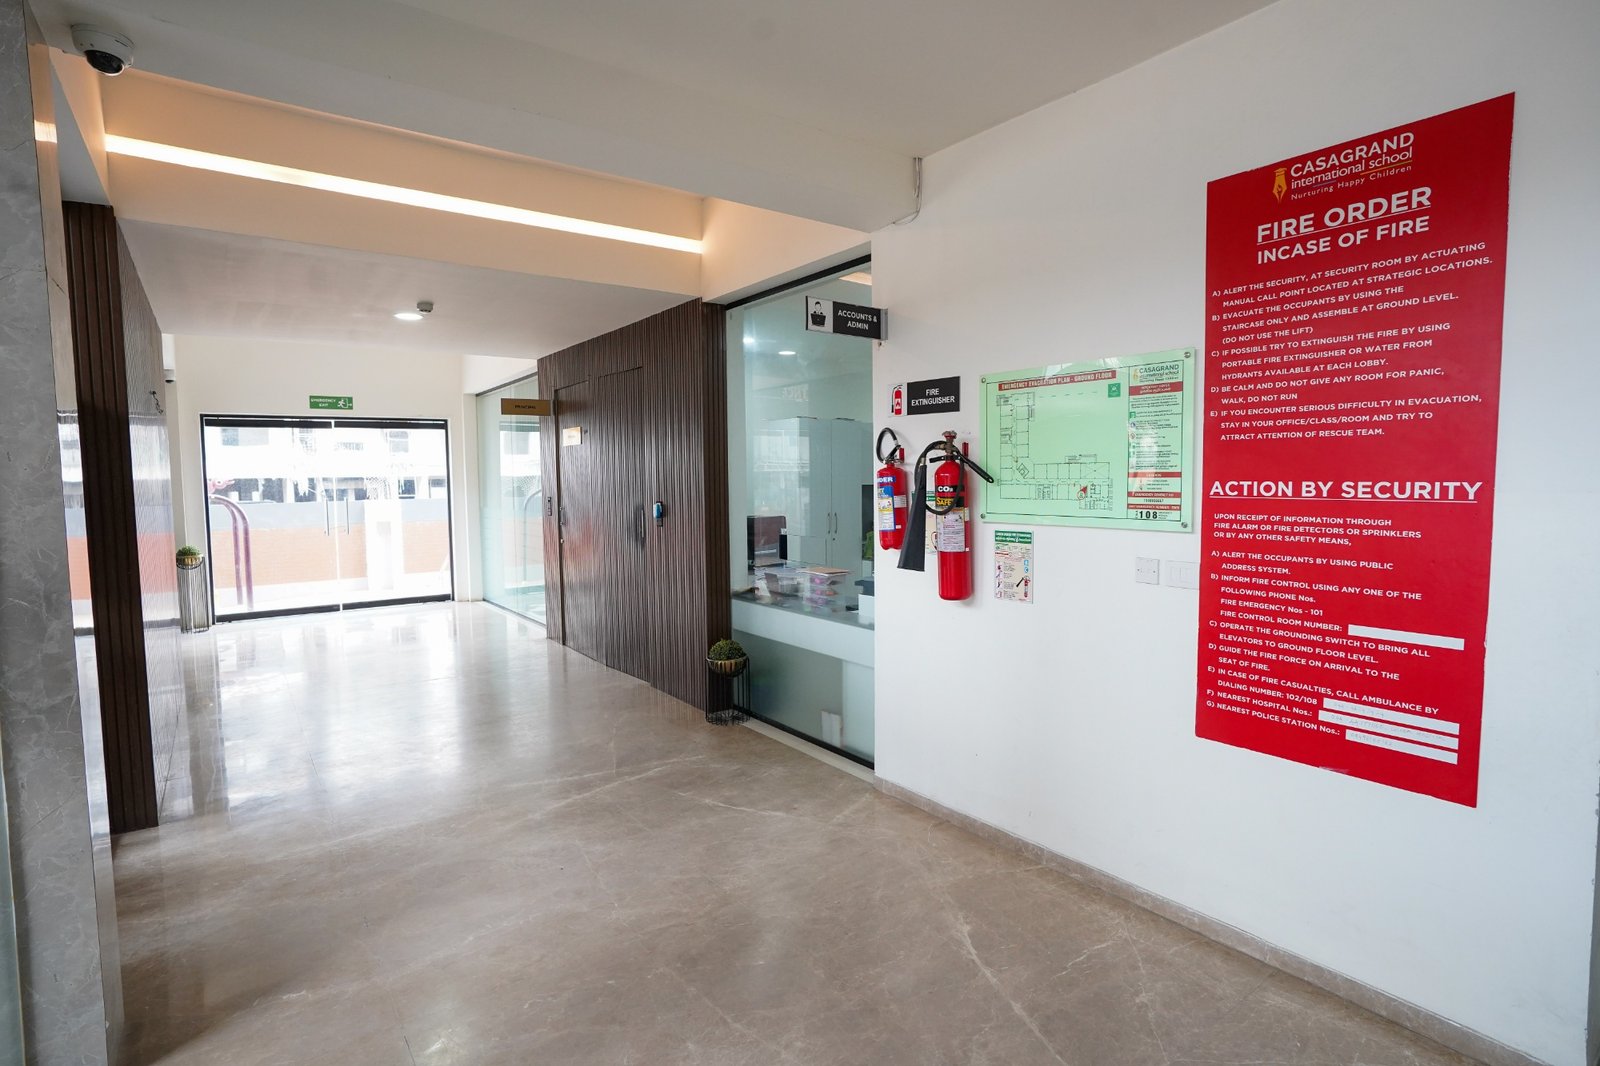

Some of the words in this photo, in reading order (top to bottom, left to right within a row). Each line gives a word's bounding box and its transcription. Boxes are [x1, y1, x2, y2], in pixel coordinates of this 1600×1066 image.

[1290, 132, 1414, 177] CASAGRAND
[1291, 159, 1365, 189] international
[1368, 146, 1412, 168] school
[1291, 185, 1333, 200] Nurturing
[1337, 177, 1365, 188] Happy
[1369, 165, 1411, 180] Children
[1257, 213, 1314, 242] FIRE
[1323, 186, 1431, 227] ORDER
[1258, 236, 1331, 264] INCASE
[1338, 228, 1369, 247] OF
[1376, 215, 1429, 240] FIRE
[1223, 285, 1247, 295] ALERT
[1249, 282, 1264, 290] THE
[1266, 275, 1308, 287] SECURITY,
[1310, 271, 1322, 279] AT
[1324, 263, 1369, 277] SECURITY
[1371, 257, 1401, 269] ROOM
[1404, 254, 1418, 263] BY
[1421, 242, 1485, 260] ACTUATING
[1223, 297, 1255, 307] MANUAL
[1257, 293, 1277, 301] CALL
[1279, 288, 1305, 298] POINT
[1307, 281, 1349, 293] LOCATED
[1351, 278, 1364, 286] AT
[1366, 268, 1422, 283] STRATEGIC
[1425, 256, 1492, 274] LOCATIONS.
[1222, 307, 1263, 319] EVACUATE
[1265, 304, 1281, 312] THE
[1283, 296, 1336, 310] OCCUPANTS
[1338, 294, 1350, 302] BY
[1352, 289, 1382, 299] USING
[1384, 285, 1404, 294] THE
[838, 309, 872, 321] ACCOUNTS
[847, 321, 869, 330] ADMIN
[1231, 345, 1267, 354] POSSIBLE
[1269, 342, 1285, 350] TRY
[1301, 334, 1353, 347] EXTINGUISH
[1356, 332, 1374, 340] THE
[1377, 328, 1398, 338] FIRE
[1401, 327, 1415, 335] BY
[1417, 322, 1450, 333] USING
[1139, 364, 1179, 373] CASAGRAND
[1309, 377, 1330, 385] GIVE
[1332, 375, 1352, 383] ANY
[1354, 372, 1383, 381] ROOM
[1385, 370, 1406, 378] FOR
[1409, 367, 1444, 376] PANIC,
[925, 388, 940, 396] FIRE
[1029, 379, 1057, 387] EVACUATION
[911, 395, 955, 406] EXTINGUISHER
[1247, 406, 1296, 415] ENCOUNTER
[1298, 403, 1335, 412] SERIOUS
[1337, 400, 1392, 409] DIFFICULTY
[1408, 394, 1481, 405] EVACUATION,
[1256, 431, 1302, 439] ATTENTION
[1319, 429, 1353, 437] RESCUE
[1209, 480, 1292, 496] ACTION
[1301, 481, 1333, 497] BY
[1341, 481, 1482, 500] SECURITY
[936, 497, 953, 506] SAFE
[1139, 511, 1158, 519] 108
[1283, 515, 1343, 524] INFORMATION
[1345, 518, 1391, 526] THROUGH
[1255, 533, 1282, 541] OTHER
[1318, 537, 1351, 546] MEANS,
[1221, 563, 1256, 571] ADDRESS
[1257, 566, 1291, 574] SYSTEM.
[1263, 554, 1314, 563] OCCUPANTS
[1329, 558, 1357, 567] USING
[1359, 561, 1393, 570] PUBLIC
[1238, 612, 1275, 622] CONTROL
[1277, 617, 1301, 626] ROOM
[1303, 620, 1342, 631] NUMBER:
[1219, 621, 1254, 632] OPERATE
[1255, 626, 1271, 634] THE
[1272, 629, 1323, 642] GROUNDING
[1325, 636, 1360, 647] SWITCH
[1362, 641, 1376, 649] TO
[1378, 643, 1408, 654] BRING
[1410, 648, 1430, 657] ALL
[1217, 679, 1247, 690] DIALING
[1249, 686, 1284, 698] NUMBER:
[1286, 693, 1317, 705] 102/108
[1217, 691, 1250, 703] NEAREST
[1252, 698, 1290, 712] HOSPITAL
[1227, 670, 1247, 679] CASE
[1261, 676, 1278, 685] FIRE
[1280, 679, 1334, 696] CASUALTIES,
[1336, 690, 1359, 700] CALL
[1361, 695, 1422, 712] AMBULANCE
[1424, 706, 1439, 714] BY
[1216, 702, 1250, 715] NEAREST
[1251, 710, 1279, 722] POLICE
[1281, 717, 1317, 730] STATION
